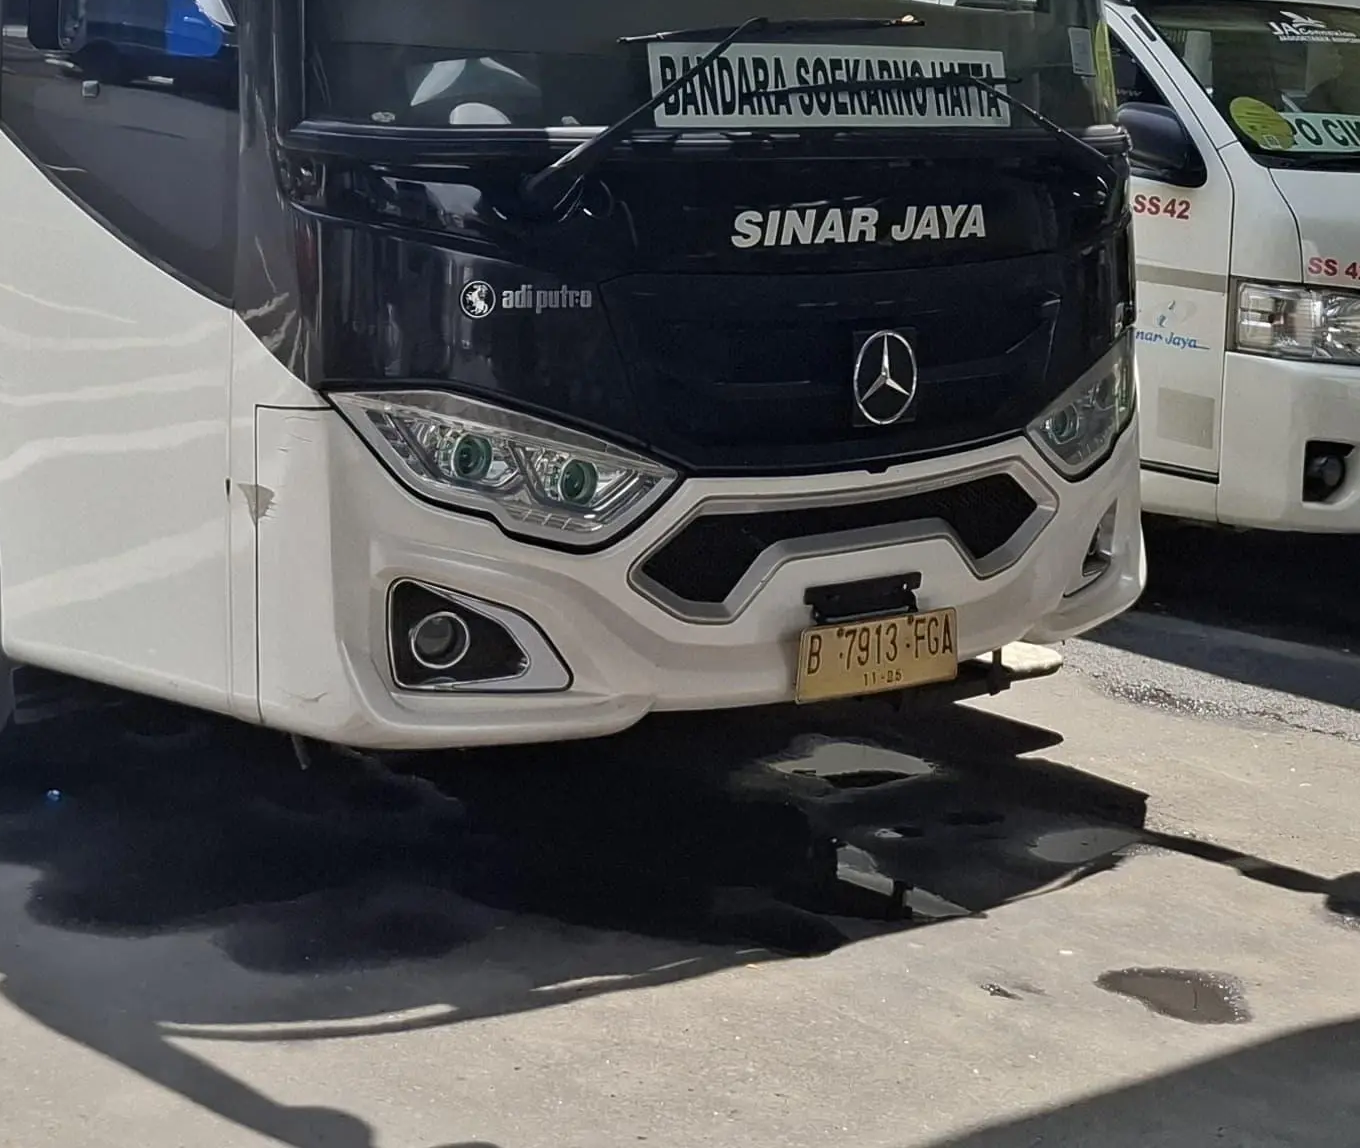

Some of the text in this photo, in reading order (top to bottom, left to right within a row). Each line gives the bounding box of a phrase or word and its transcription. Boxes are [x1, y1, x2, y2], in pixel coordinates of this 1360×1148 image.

[659, 55, 792, 117] BANDARA
[795, 56, 928, 117] SOEKARNO
[731, 203, 987, 249] SINAR JAYA
[1308, 256, 1339, 277] SS
[1135, 330, 1162, 343] nar
[807, 614, 954, 674] B 7913 FGA
